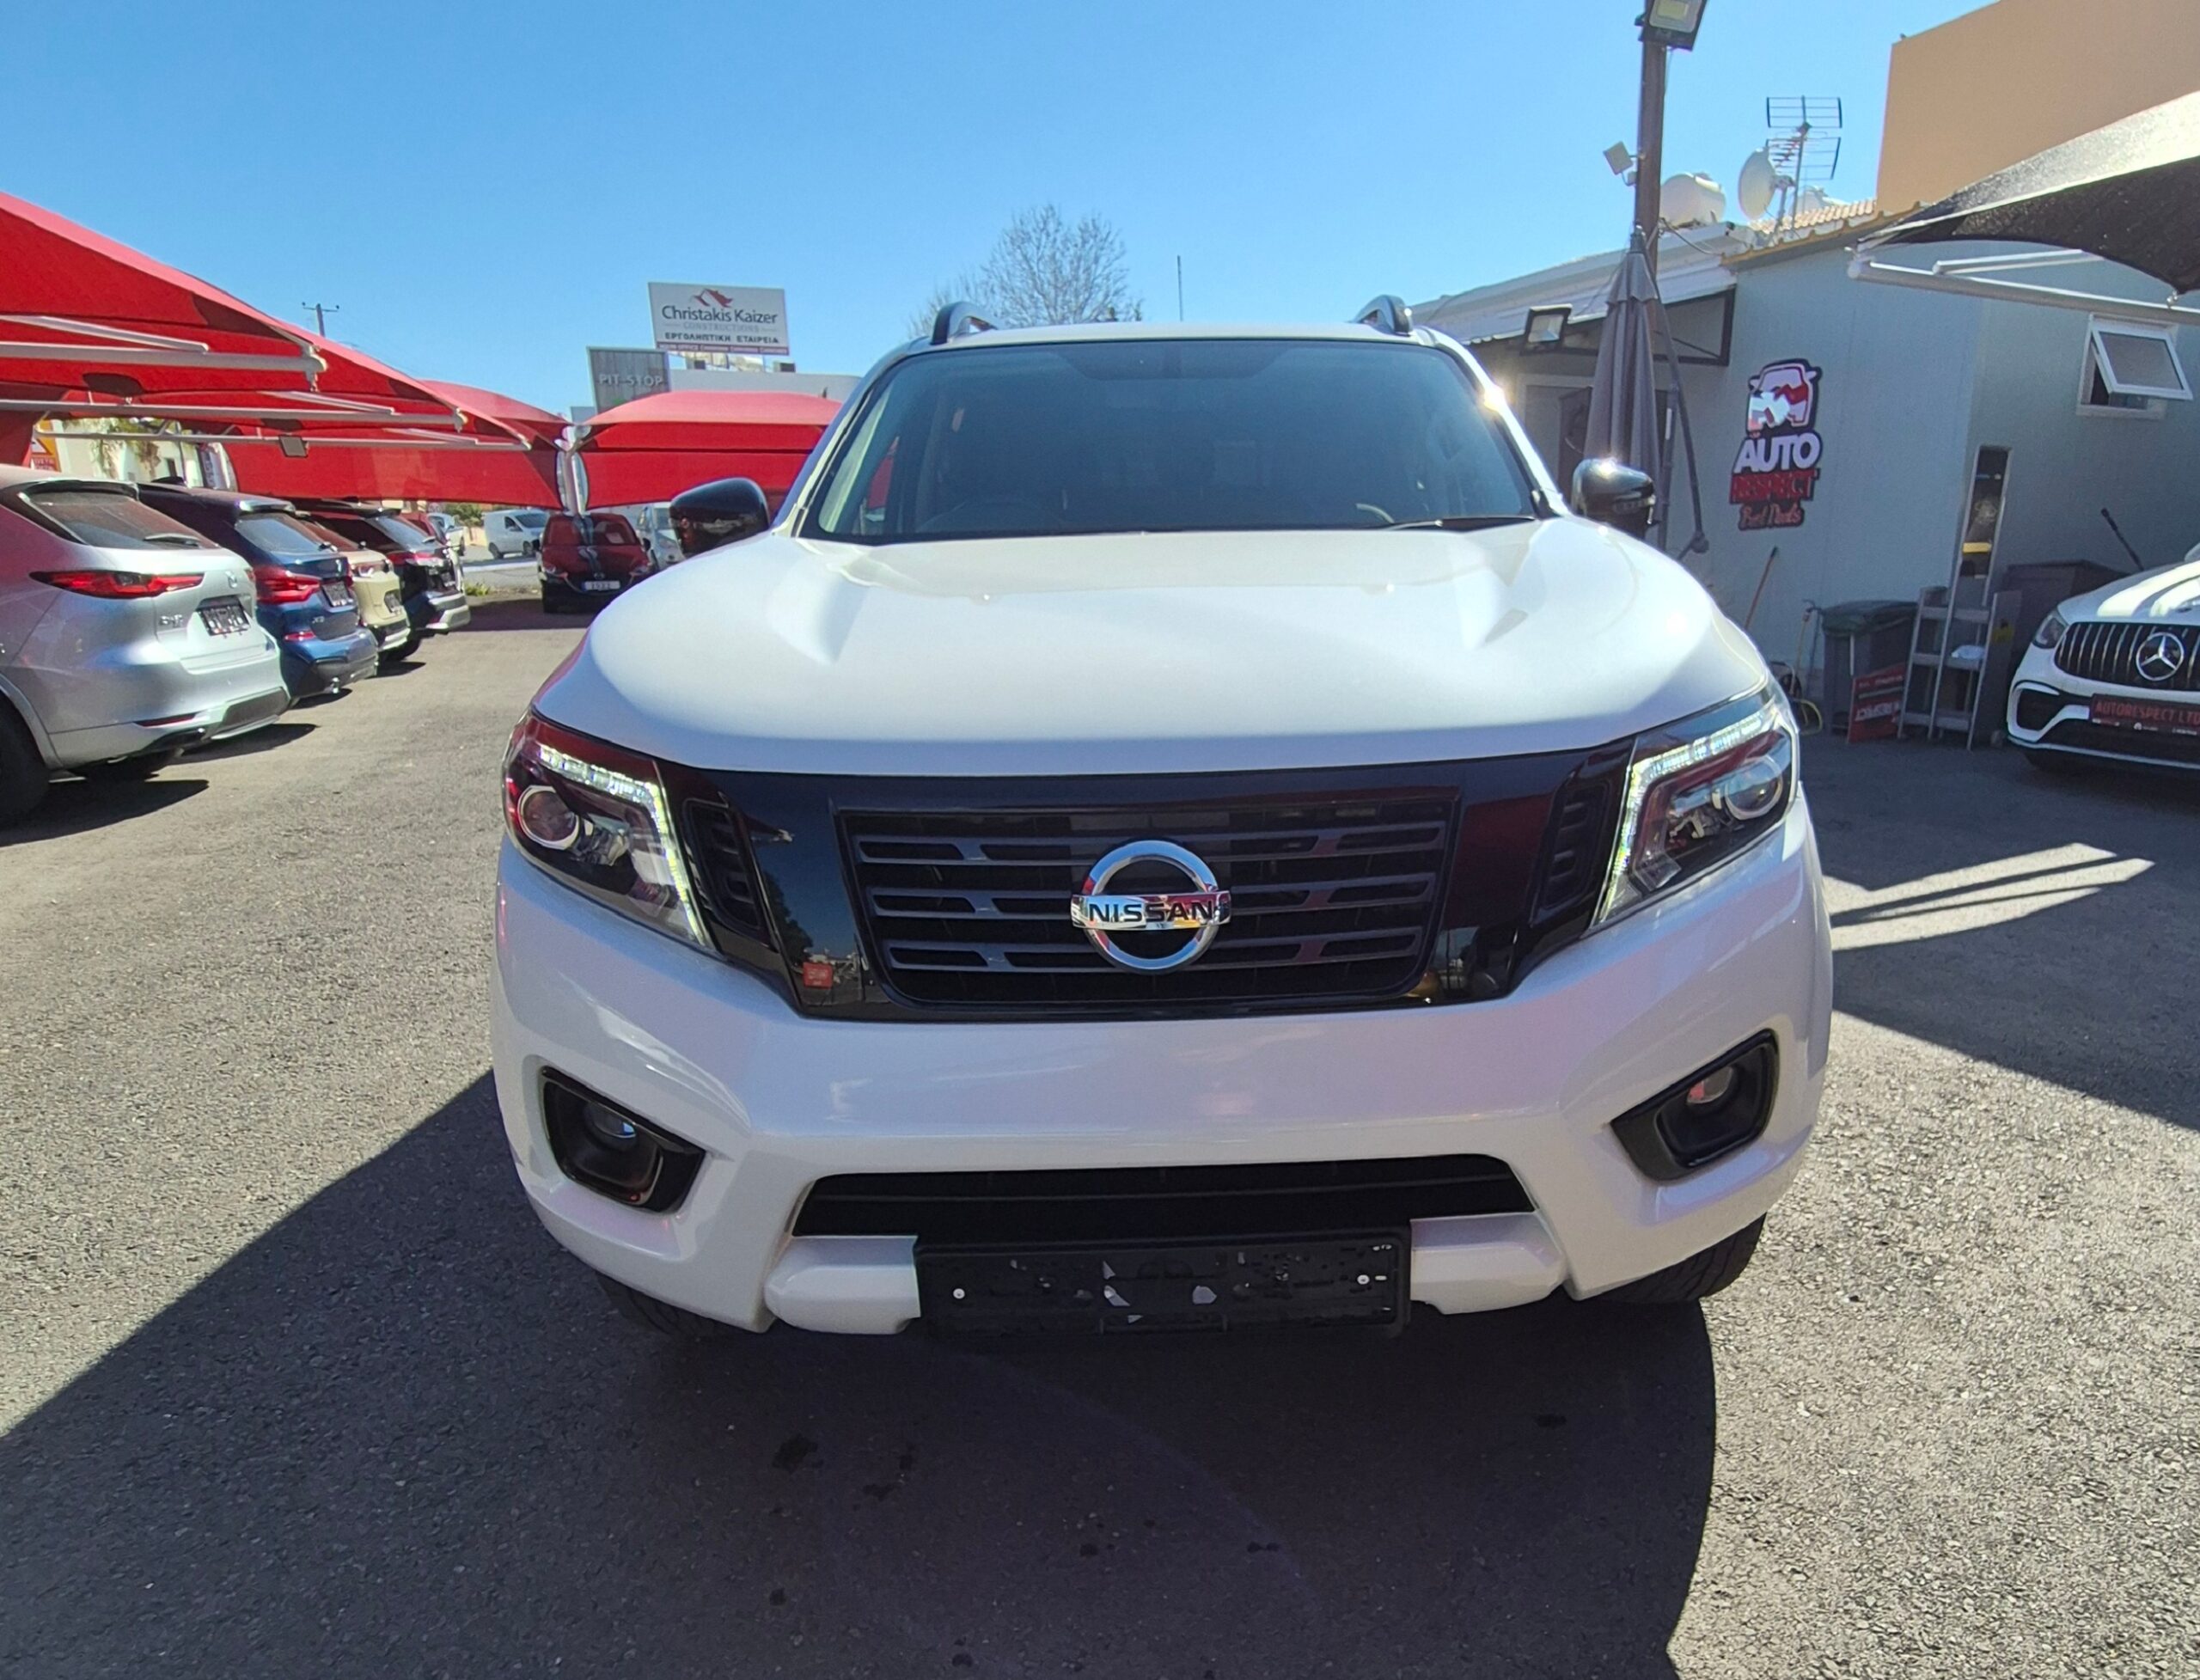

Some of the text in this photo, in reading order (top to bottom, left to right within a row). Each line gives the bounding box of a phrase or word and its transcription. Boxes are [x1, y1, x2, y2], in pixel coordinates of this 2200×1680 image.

[662, 305, 778, 323] Christakis Kaizer
[683, 322, 759, 333] CONSTRUCTIONS
[1734, 432, 1820, 473] AUTO
[2095, 701, 2174, 722] AUTORESPECT
[1089, 901, 1213, 922] NISSAN
